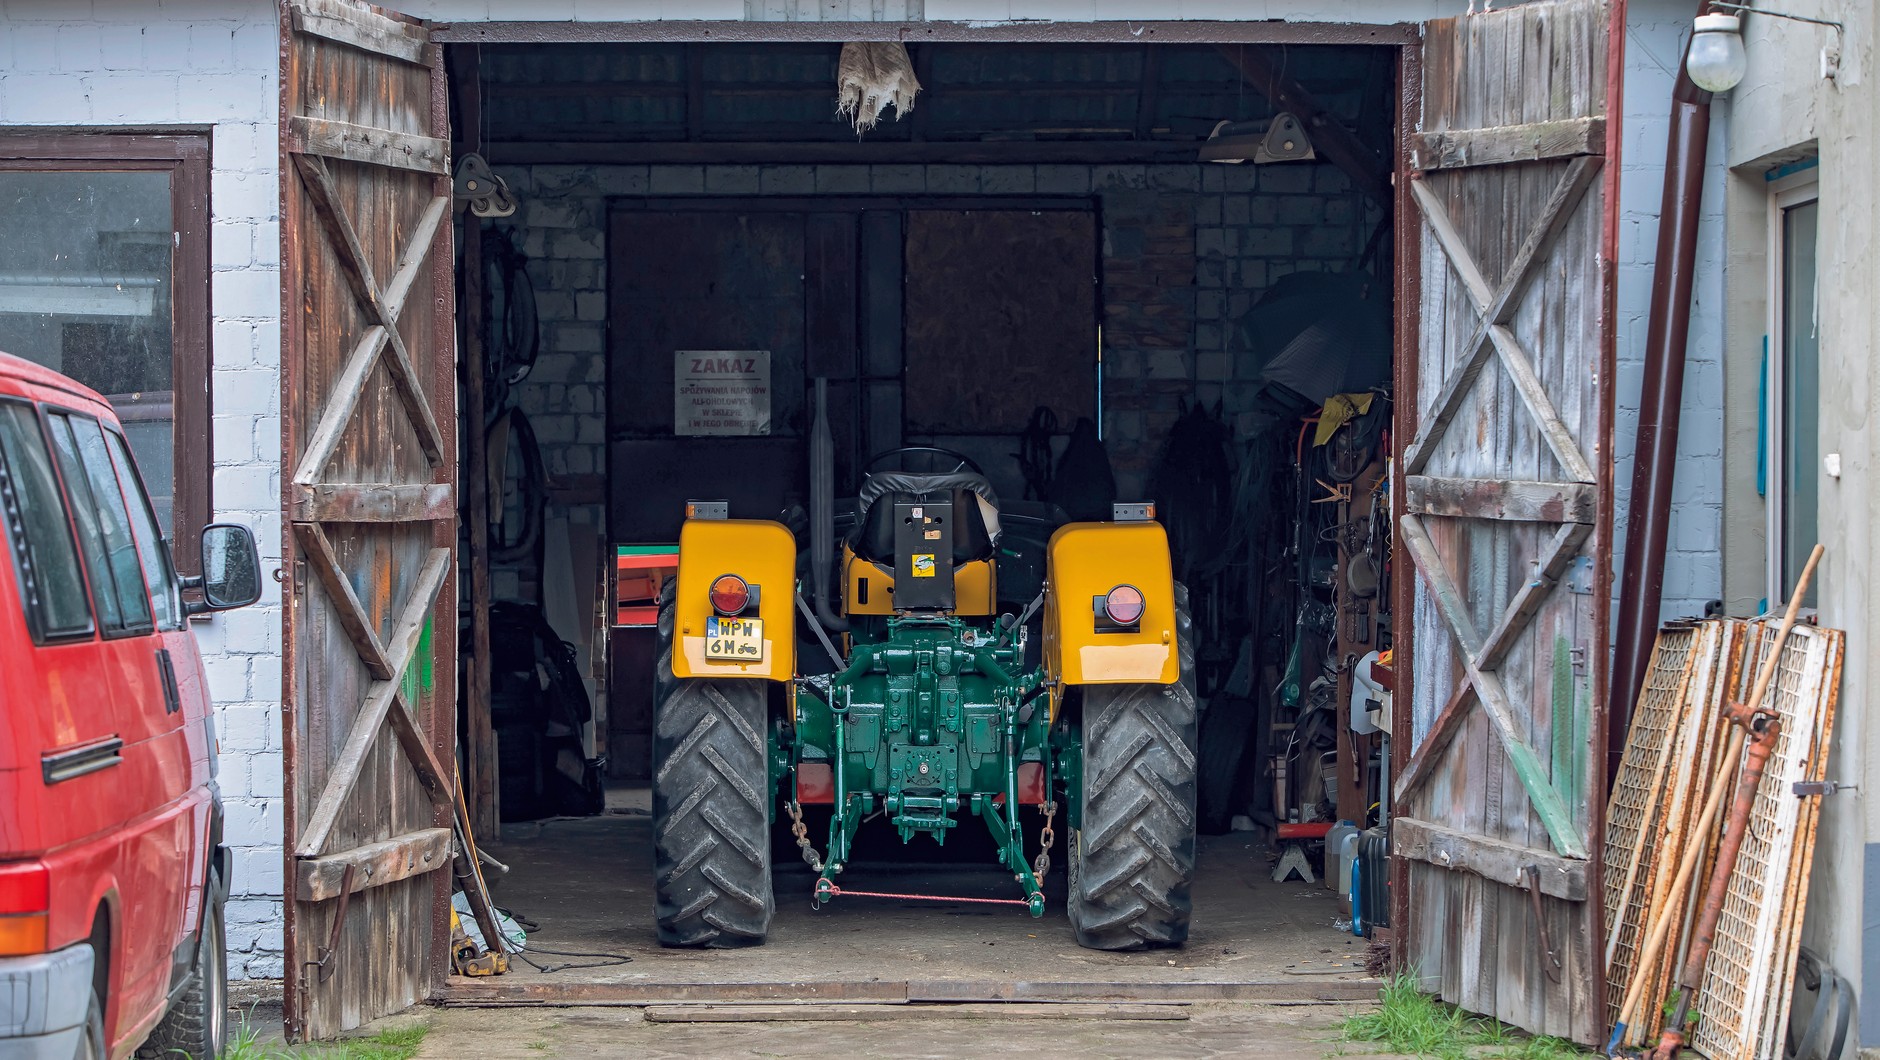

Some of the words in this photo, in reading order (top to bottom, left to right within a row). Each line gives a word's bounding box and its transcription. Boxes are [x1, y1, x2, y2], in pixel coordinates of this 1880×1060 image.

[691, 359, 756, 373] ZAKAZ
[730, 385, 767, 395] NAPOJÓW
[693, 420, 701, 428] W
[702, 420, 721, 428] JEGO
[721, 622, 753, 636] WPW
